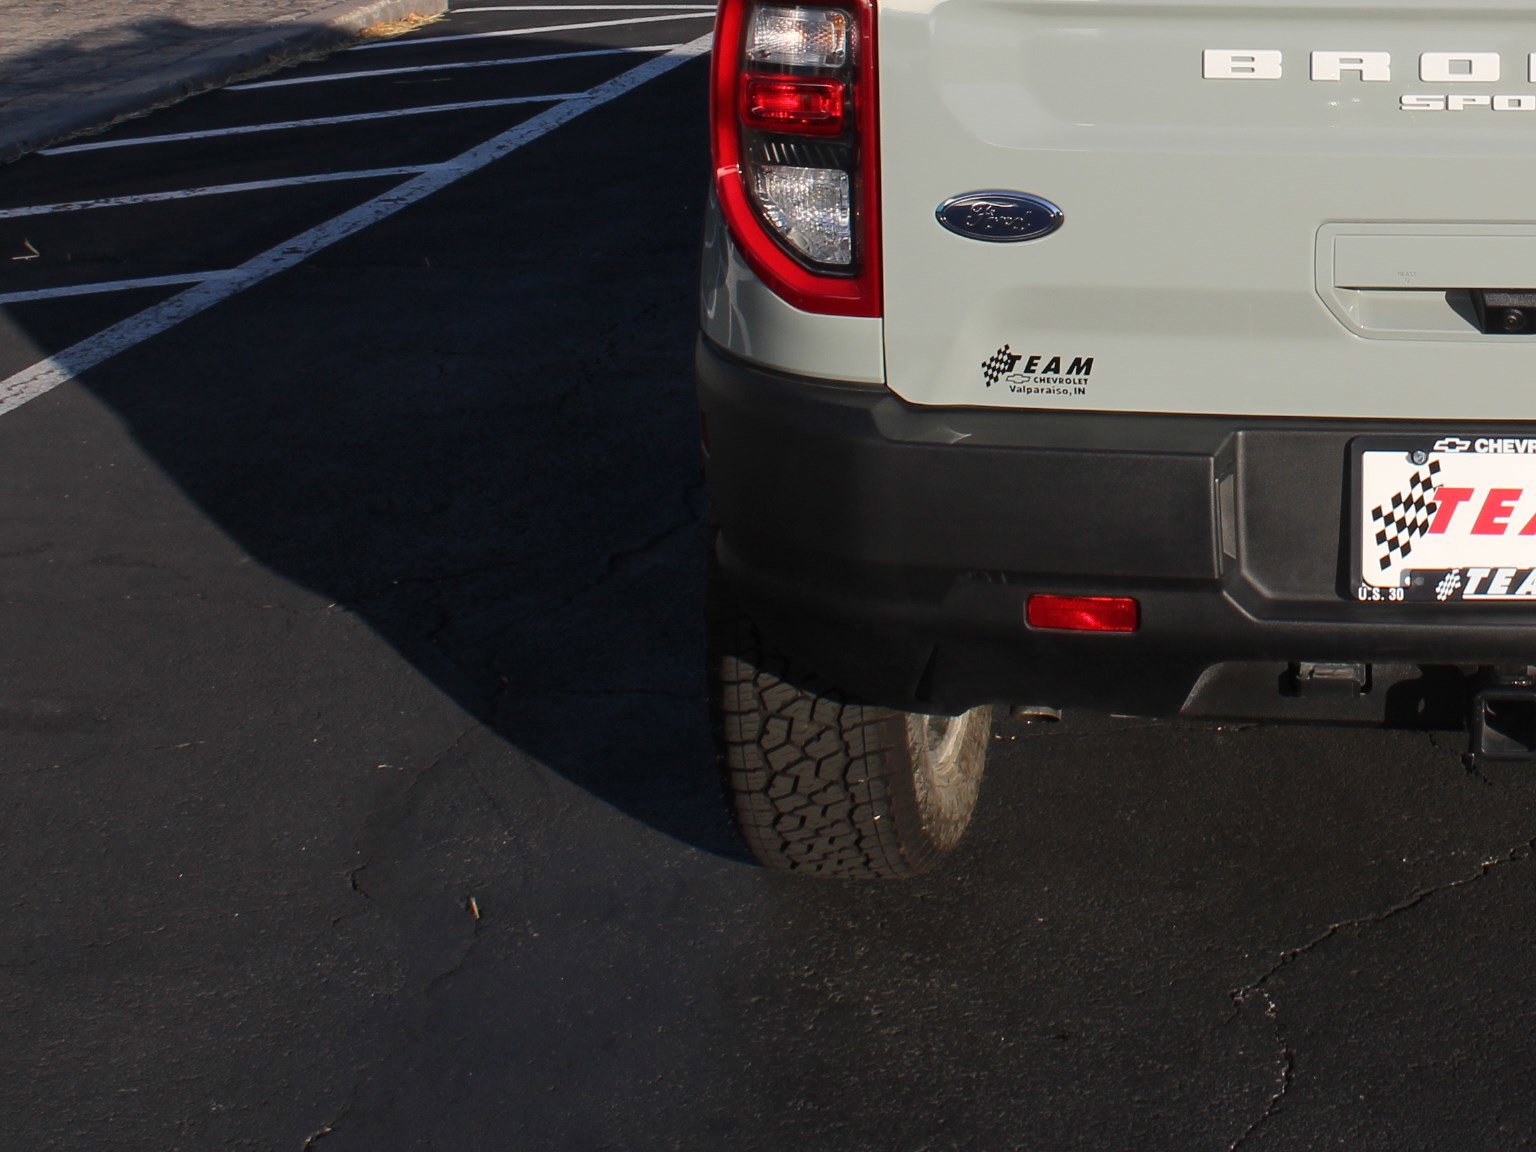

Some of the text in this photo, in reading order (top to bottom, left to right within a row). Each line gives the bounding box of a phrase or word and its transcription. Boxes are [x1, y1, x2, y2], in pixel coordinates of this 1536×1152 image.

[965, 202, 1033, 231] Ford
[1005, 354, 1094, 376] TEAM
[1034, 376, 1088, 385] CHEVROLET
[1009, 385, 1086, 396] Valparaiso, IN
[1358, 587, 1405, 601] U.S. 30
